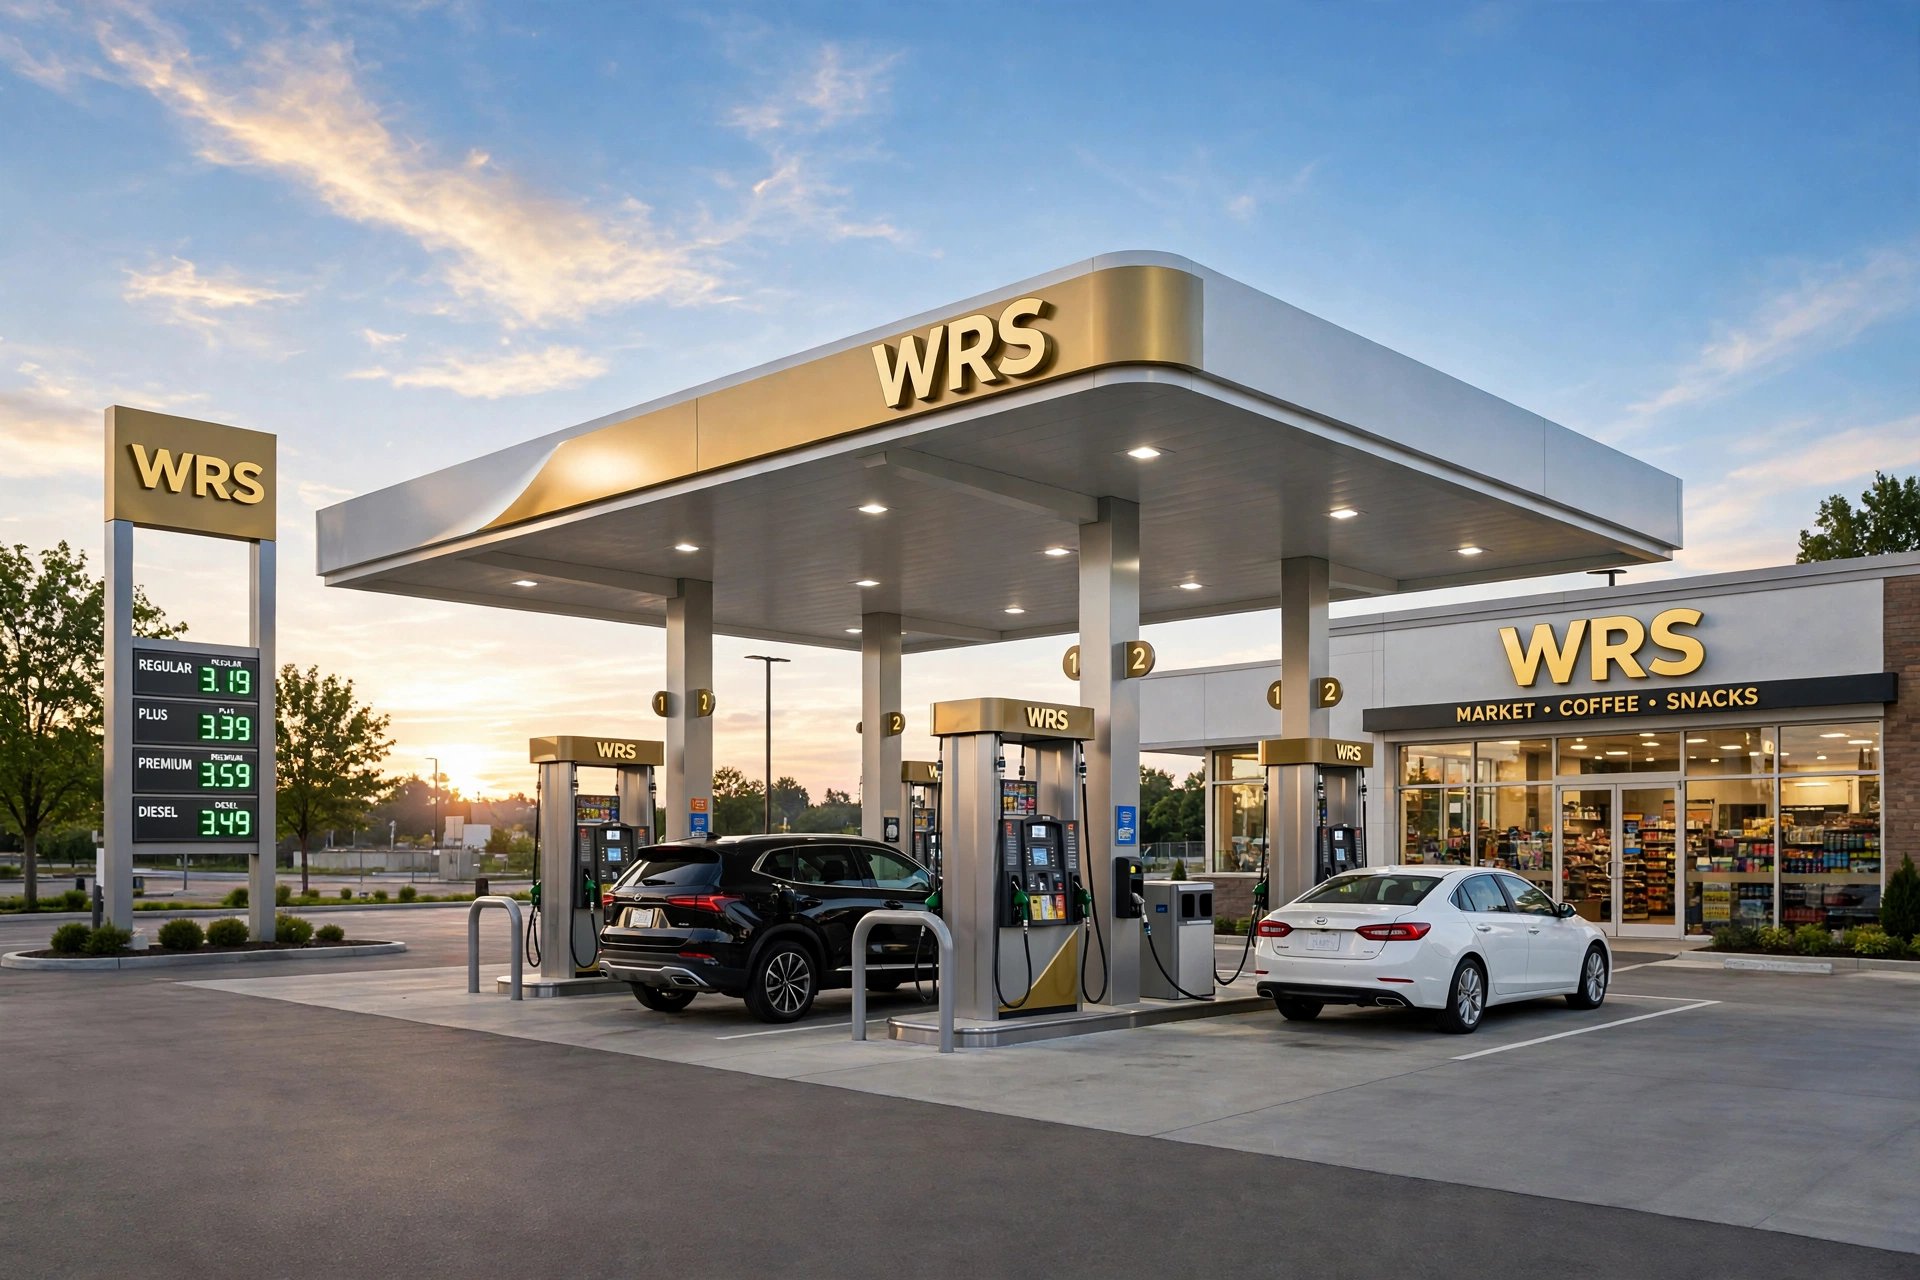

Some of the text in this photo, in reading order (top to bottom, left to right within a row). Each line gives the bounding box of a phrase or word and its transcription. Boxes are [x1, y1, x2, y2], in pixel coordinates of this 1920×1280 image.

[871, 297, 1051, 409] WRS
[129, 443, 265, 504] WRS
[1132, 647, 1146, 670] 2
[1498, 607, 1705, 687] WRS
[1069, 652, 1077, 674] 1
[138, 659, 250, 694] REGULAR 3.19
[702, 694, 708, 710] 2
[1272, 686, 1280, 705] 1
[1324, 682, 1336, 701] 2
[657, 696, 664, 712] 1
[1456, 687, 1758, 722] MARKET COFFEE SNACKS
[138, 708, 250, 741] PLUS 3.39
[892, 716, 901, 730] 2
[1027, 706, 1069, 731] WRS
[596, 742, 637, 760] WRS
[1336, 743, 1362, 762] WRS
[138, 757, 192, 770] PREMIUM
[202, 762, 250, 788] 3.59
[138, 806, 250, 836] DIESEL 3.49
